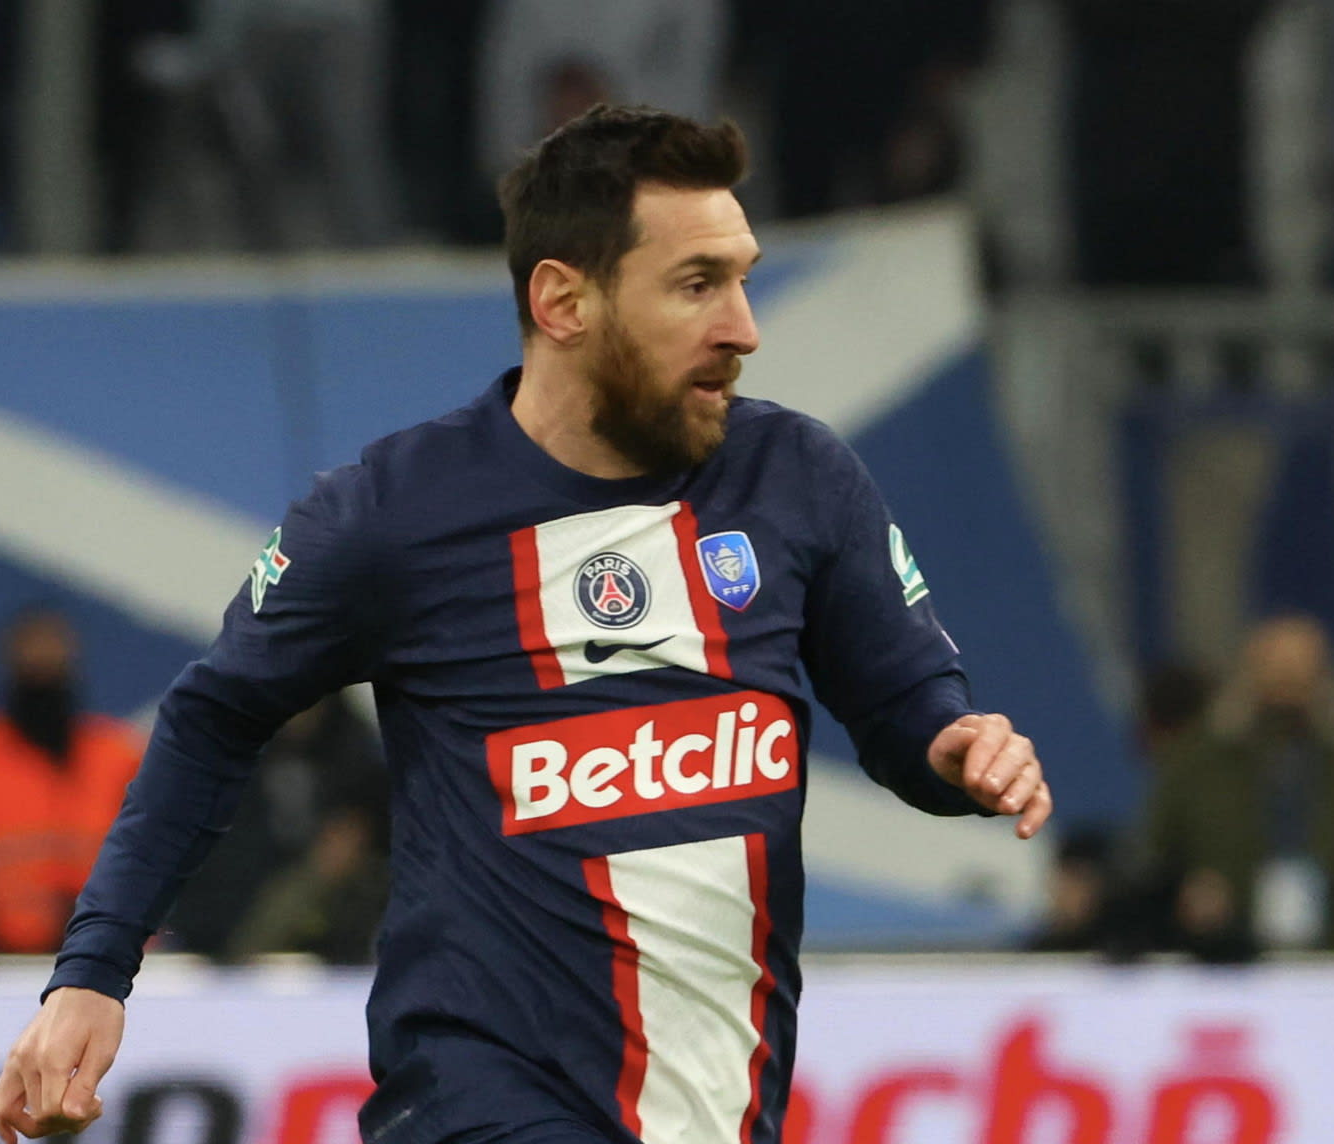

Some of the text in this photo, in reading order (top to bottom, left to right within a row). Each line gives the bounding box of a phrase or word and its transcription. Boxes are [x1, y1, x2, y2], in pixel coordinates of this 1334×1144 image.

[584, 558, 633, 579] PARIS
[722, 583, 750, 596] FFF
[511, 702, 792, 820] Betclic
